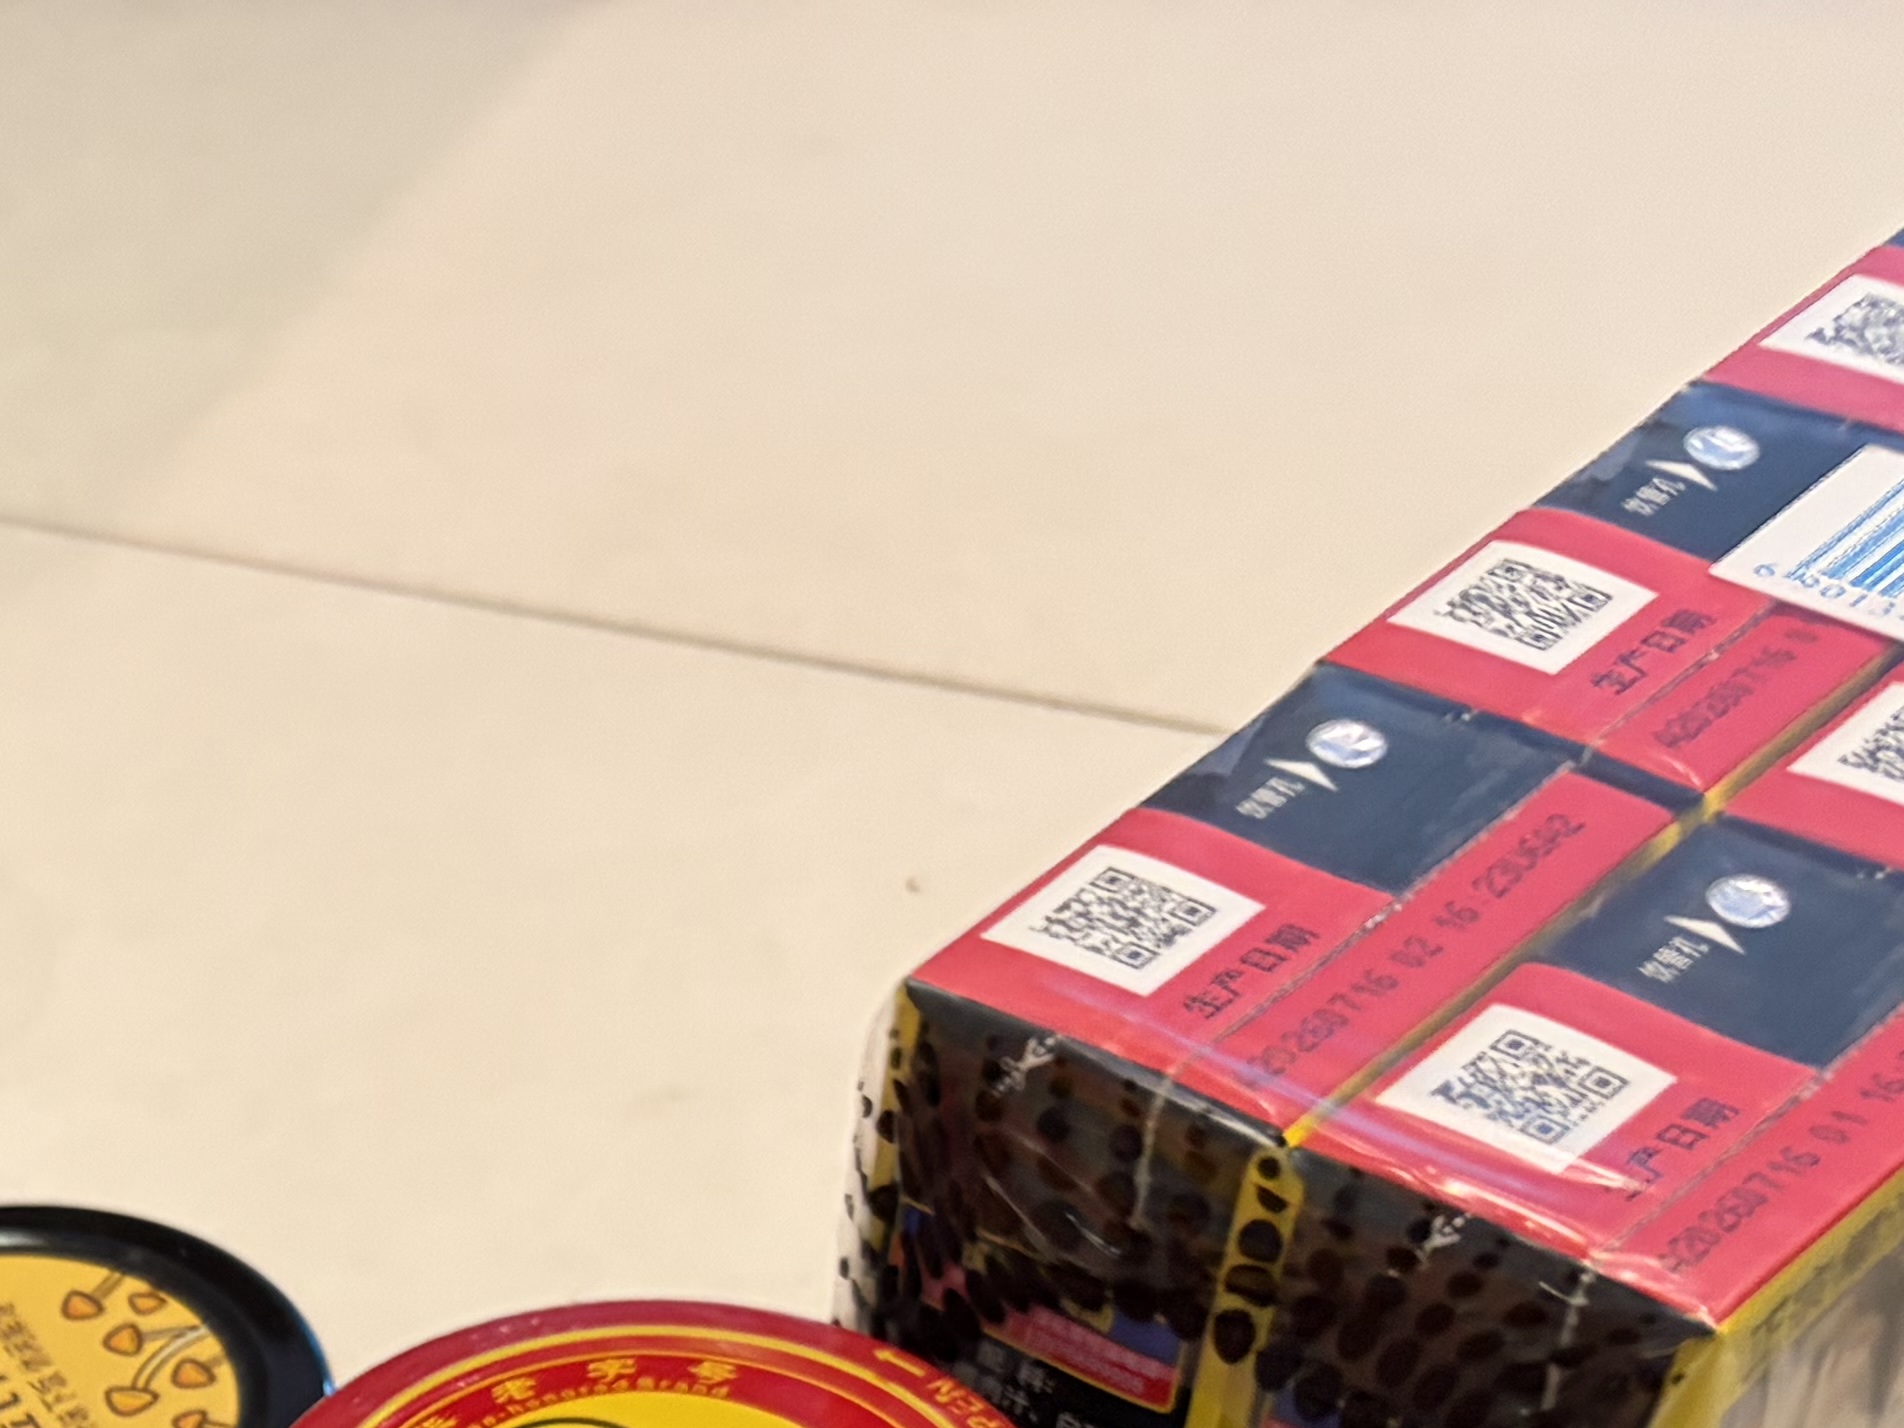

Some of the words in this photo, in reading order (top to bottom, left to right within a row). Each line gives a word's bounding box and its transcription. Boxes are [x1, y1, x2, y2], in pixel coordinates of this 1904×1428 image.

[1182, 920, 1322, 1021] 生产日期
[1625, 1096, 1741, 1203] 产日期
